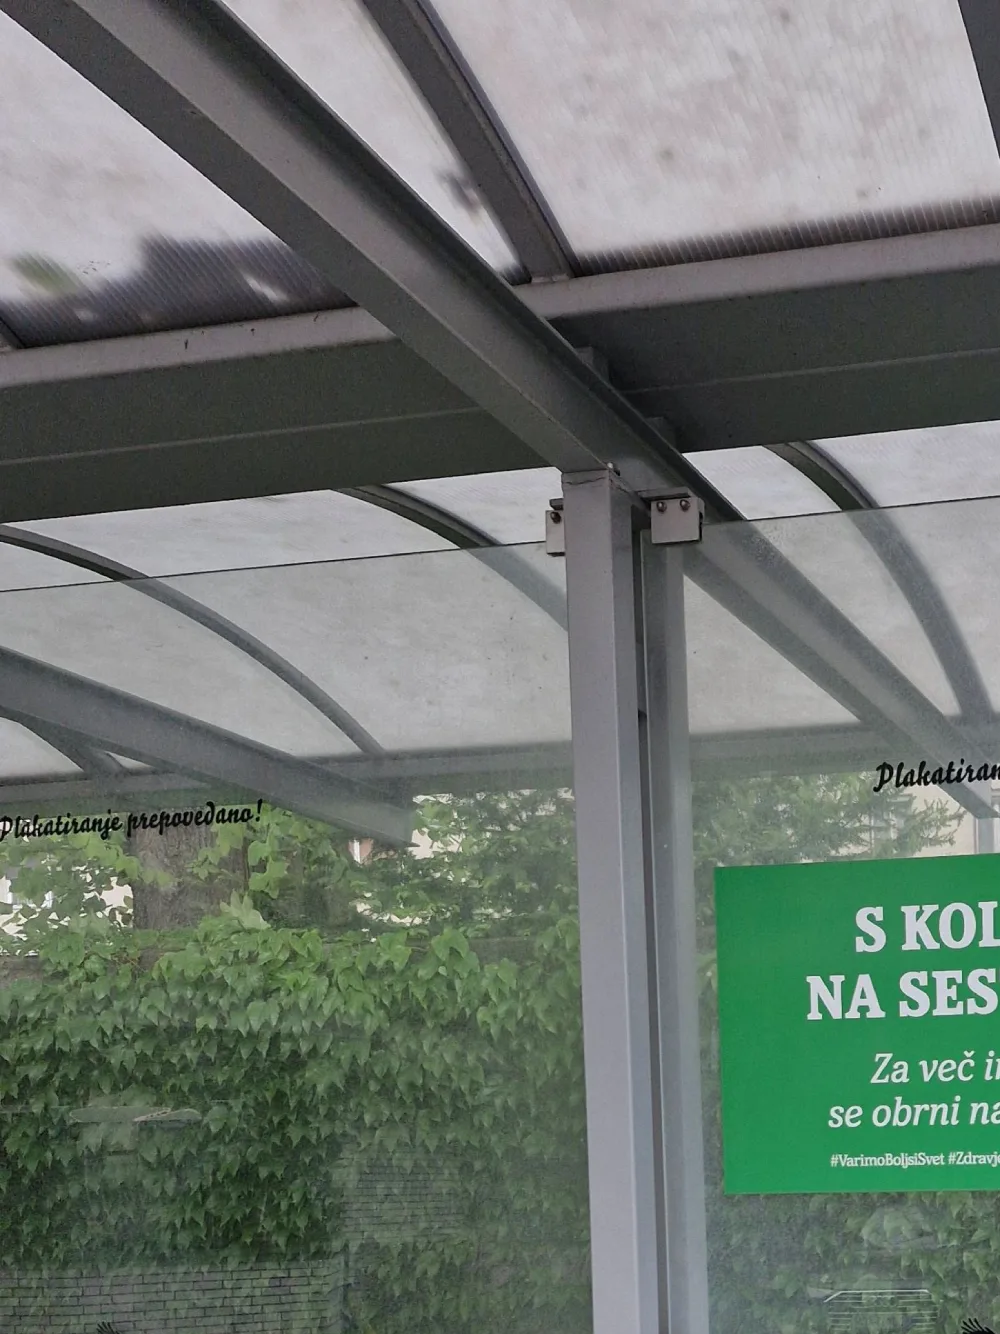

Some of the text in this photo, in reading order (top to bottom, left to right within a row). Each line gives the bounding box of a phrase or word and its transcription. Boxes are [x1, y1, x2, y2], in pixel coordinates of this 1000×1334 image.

[0, 798, 264, 843] Plakatiranje prepovedano!
[855, 906, 887, 953] S
[805, 973, 886, 1021] NA
[870, 1052, 910, 1084] Za
[918, 1050, 975, 1083] več
[827, 1105, 864, 1128] se
[871, 1095, 961, 1128] obrni
[830, 1151, 946, 1169] #VarimoBoljsiSvet
